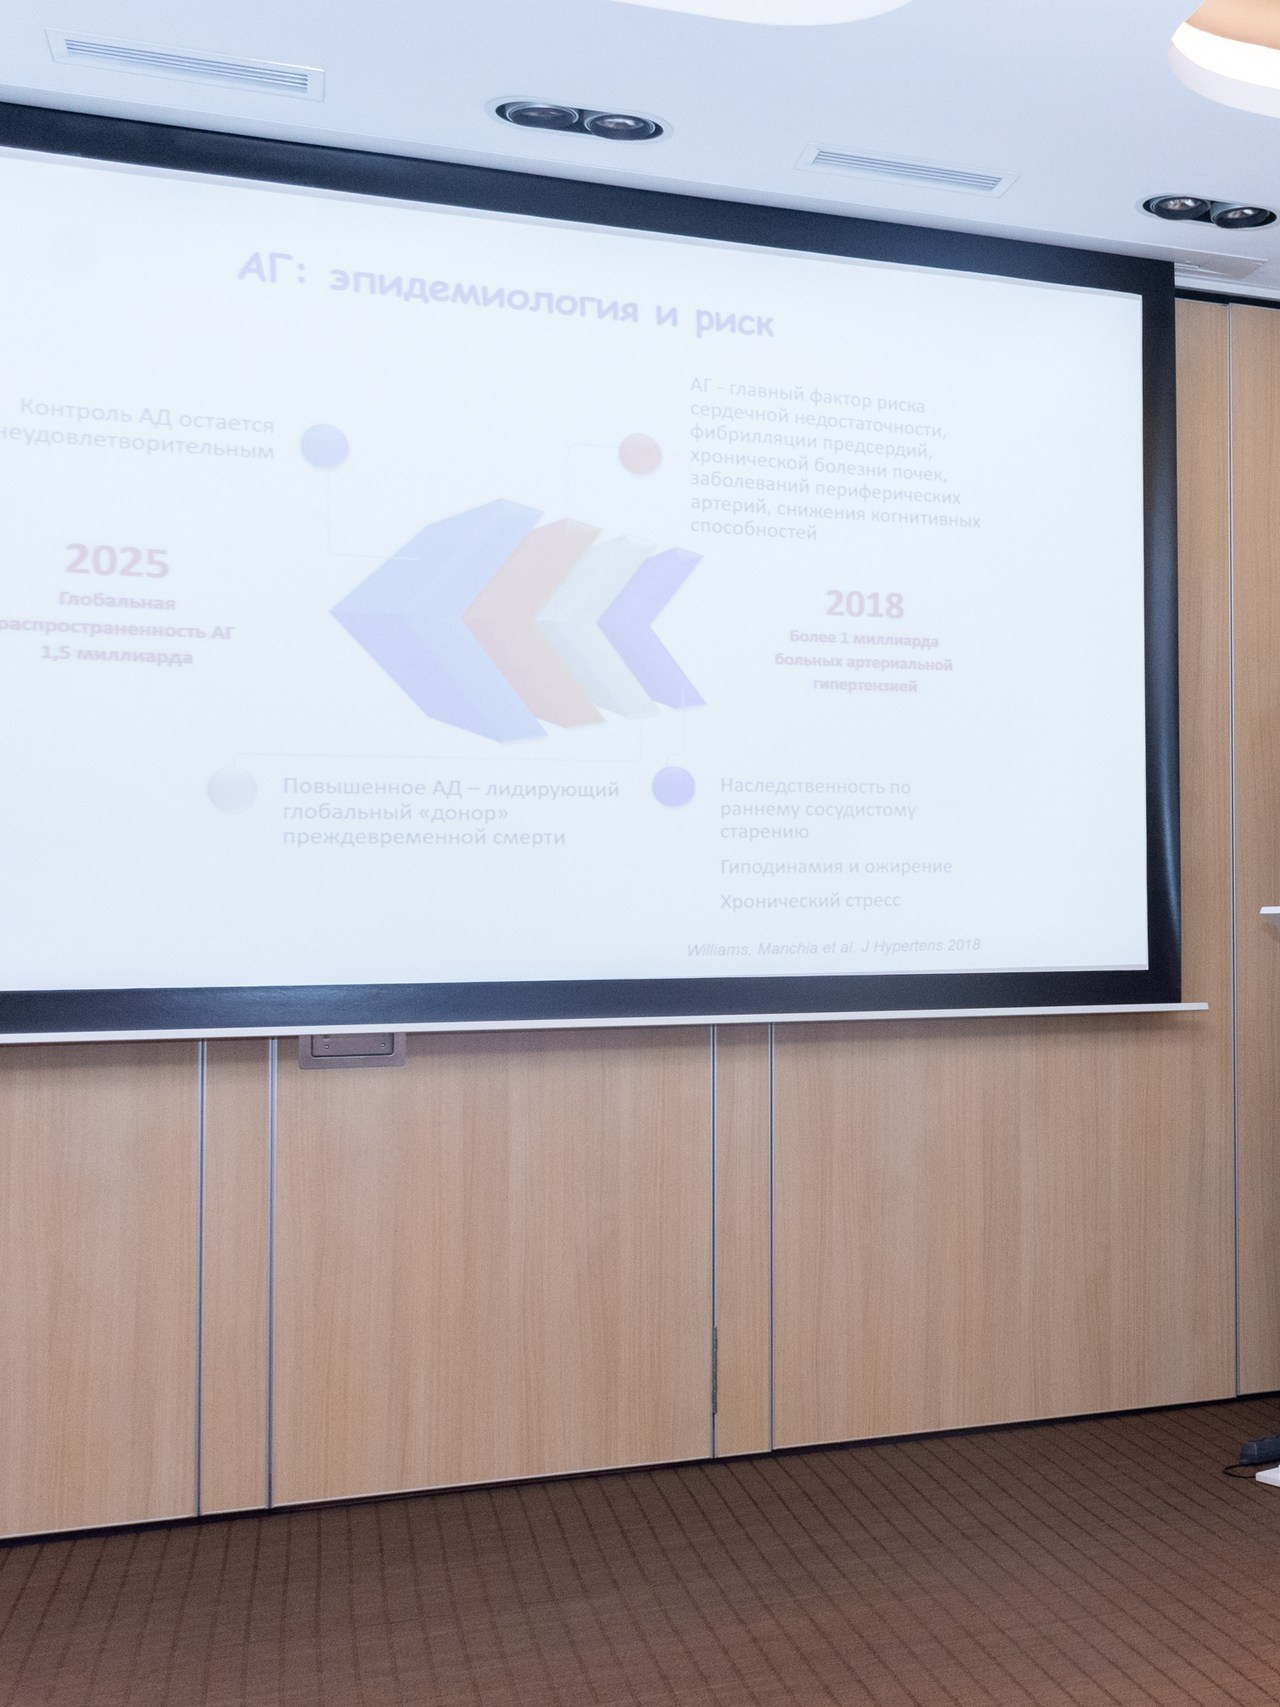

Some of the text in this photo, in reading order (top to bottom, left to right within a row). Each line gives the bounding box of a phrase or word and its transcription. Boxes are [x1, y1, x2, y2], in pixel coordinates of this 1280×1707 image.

[237, 251, 775, 339] АГ: эпидемиология и риск
[690, 377, 712, 393] АГ
[729, 382, 805, 402] главный
[809, 387, 872, 411] фактор
[877, 398, 926, 414] риска
[19, 397, 275, 434] Контроль АД остается
[690, 403, 947, 440] сердечной недостаточности,
[690, 423, 933, 460] фибрилляции предсердий,
[690, 449, 948, 485] хронической болезни почек,
[690, 471, 962, 505] заболеваний периферических
[690, 496, 981, 529] артерий, снижения когнитивных
[690, 518, 818, 541] способностей
[63, 543, 170, 579] 2025
[58, 591, 176, 611] Глобальная
[826, 589, 905, 619] 2018
[0, 618, 236, 640] распространенность АГ
[789, 629, 939, 650] Более 1 миллиарда
[40, 645, 194, 667] 1,5 миллиарда
[774, 652, 954, 672] больных артериальной
[813, 679, 918, 694] гипертензией
[283, 777, 427, 796] Повышенное
[432, 779, 463, 799] АД
[485, 781, 620, 801] лидирующий
[720, 777, 911, 796] Наследственность по
[283, 803, 508, 824] глобальный «донор»
[720, 802, 917, 821] раннему сосудистому
[283, 827, 566, 848] преждевременной смерти
[720, 825, 810, 842] старению
[720, 859, 953, 878] Гиподинамия и ожирение
[720, 892, 901, 912] Хронический стресс
[757, 942, 818, 956] Manchia
[822, 942, 836, 954] et
[861, 940, 869, 954] J
[874, 939, 943, 955] Hypertens
[948, 938, 982, 952] 2018
